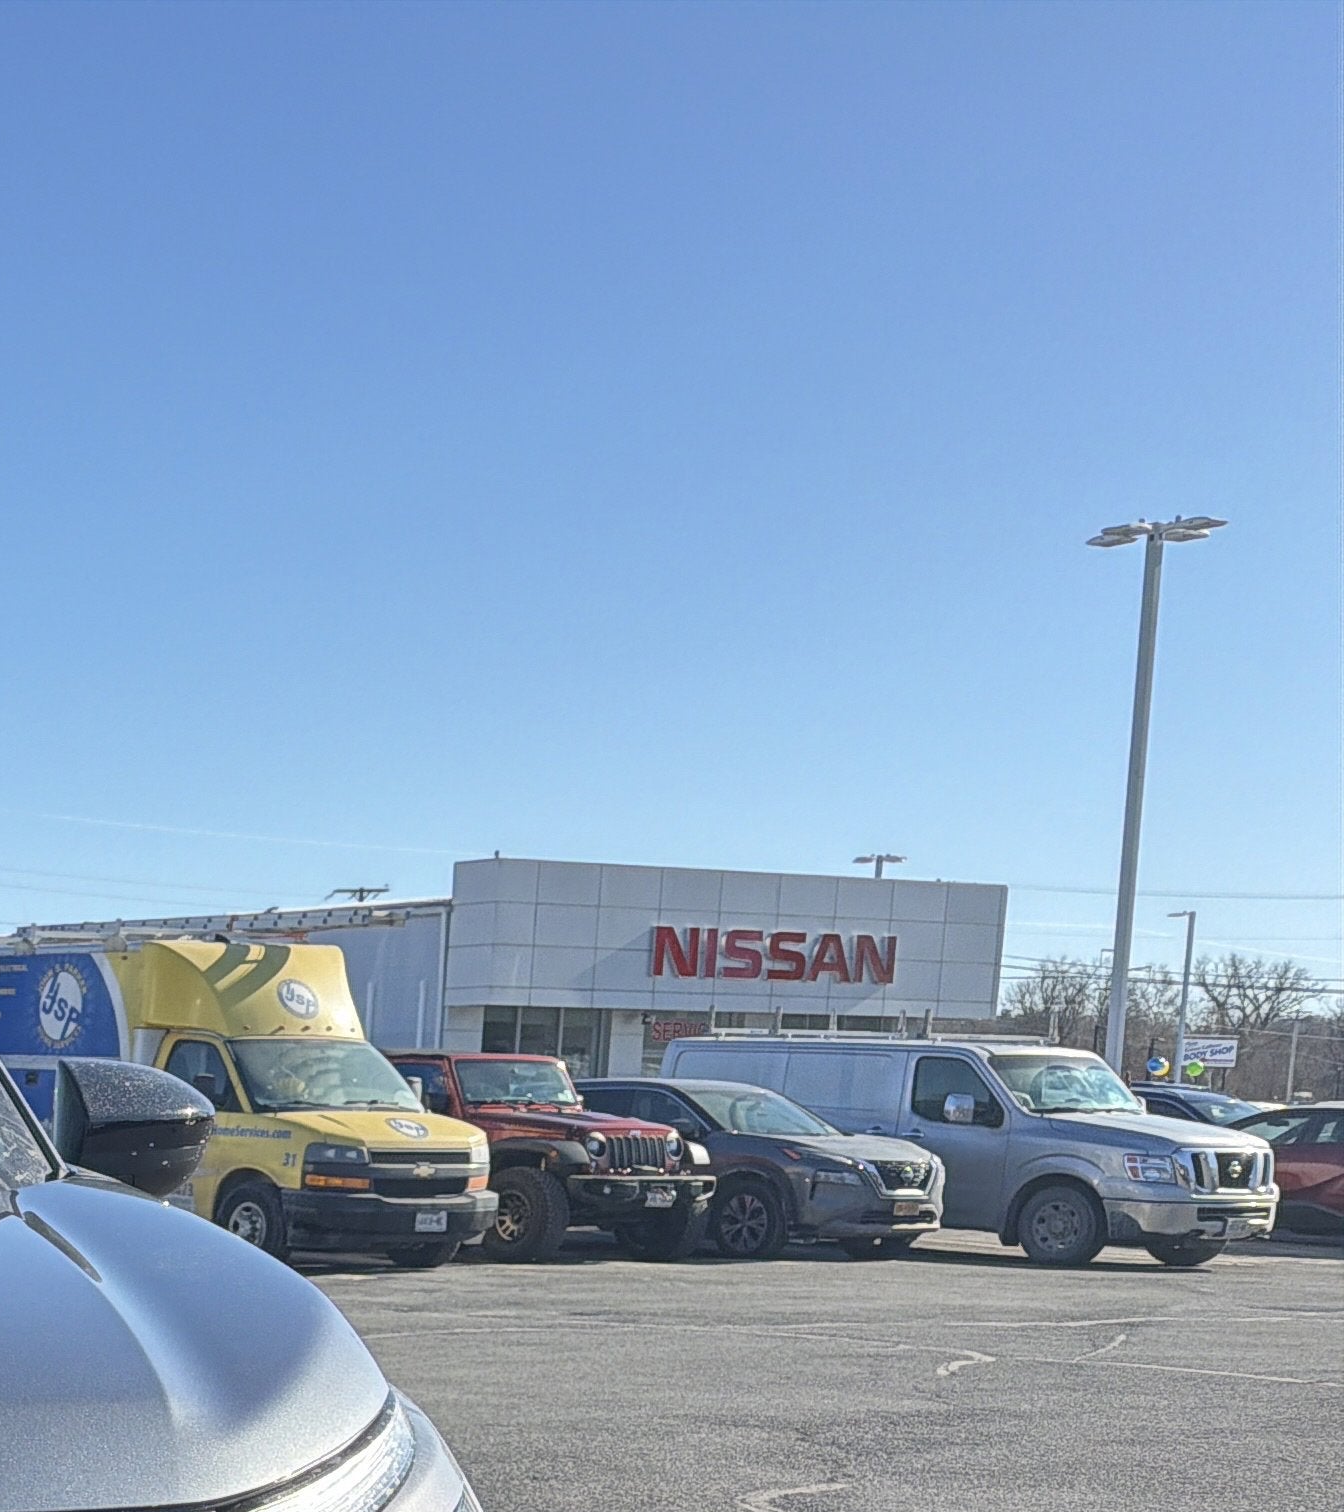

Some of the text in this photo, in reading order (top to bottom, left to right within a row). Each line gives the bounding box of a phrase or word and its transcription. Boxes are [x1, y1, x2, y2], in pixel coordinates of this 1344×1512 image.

[651, 926, 897, 984] NISSAN
[652, 1021, 711, 1042] SERVIC
[1183, 1050, 1208, 1062] BODY
[1209, 1045, 1234, 1058] SHOP
[282, 1152, 298, 1168] 31
